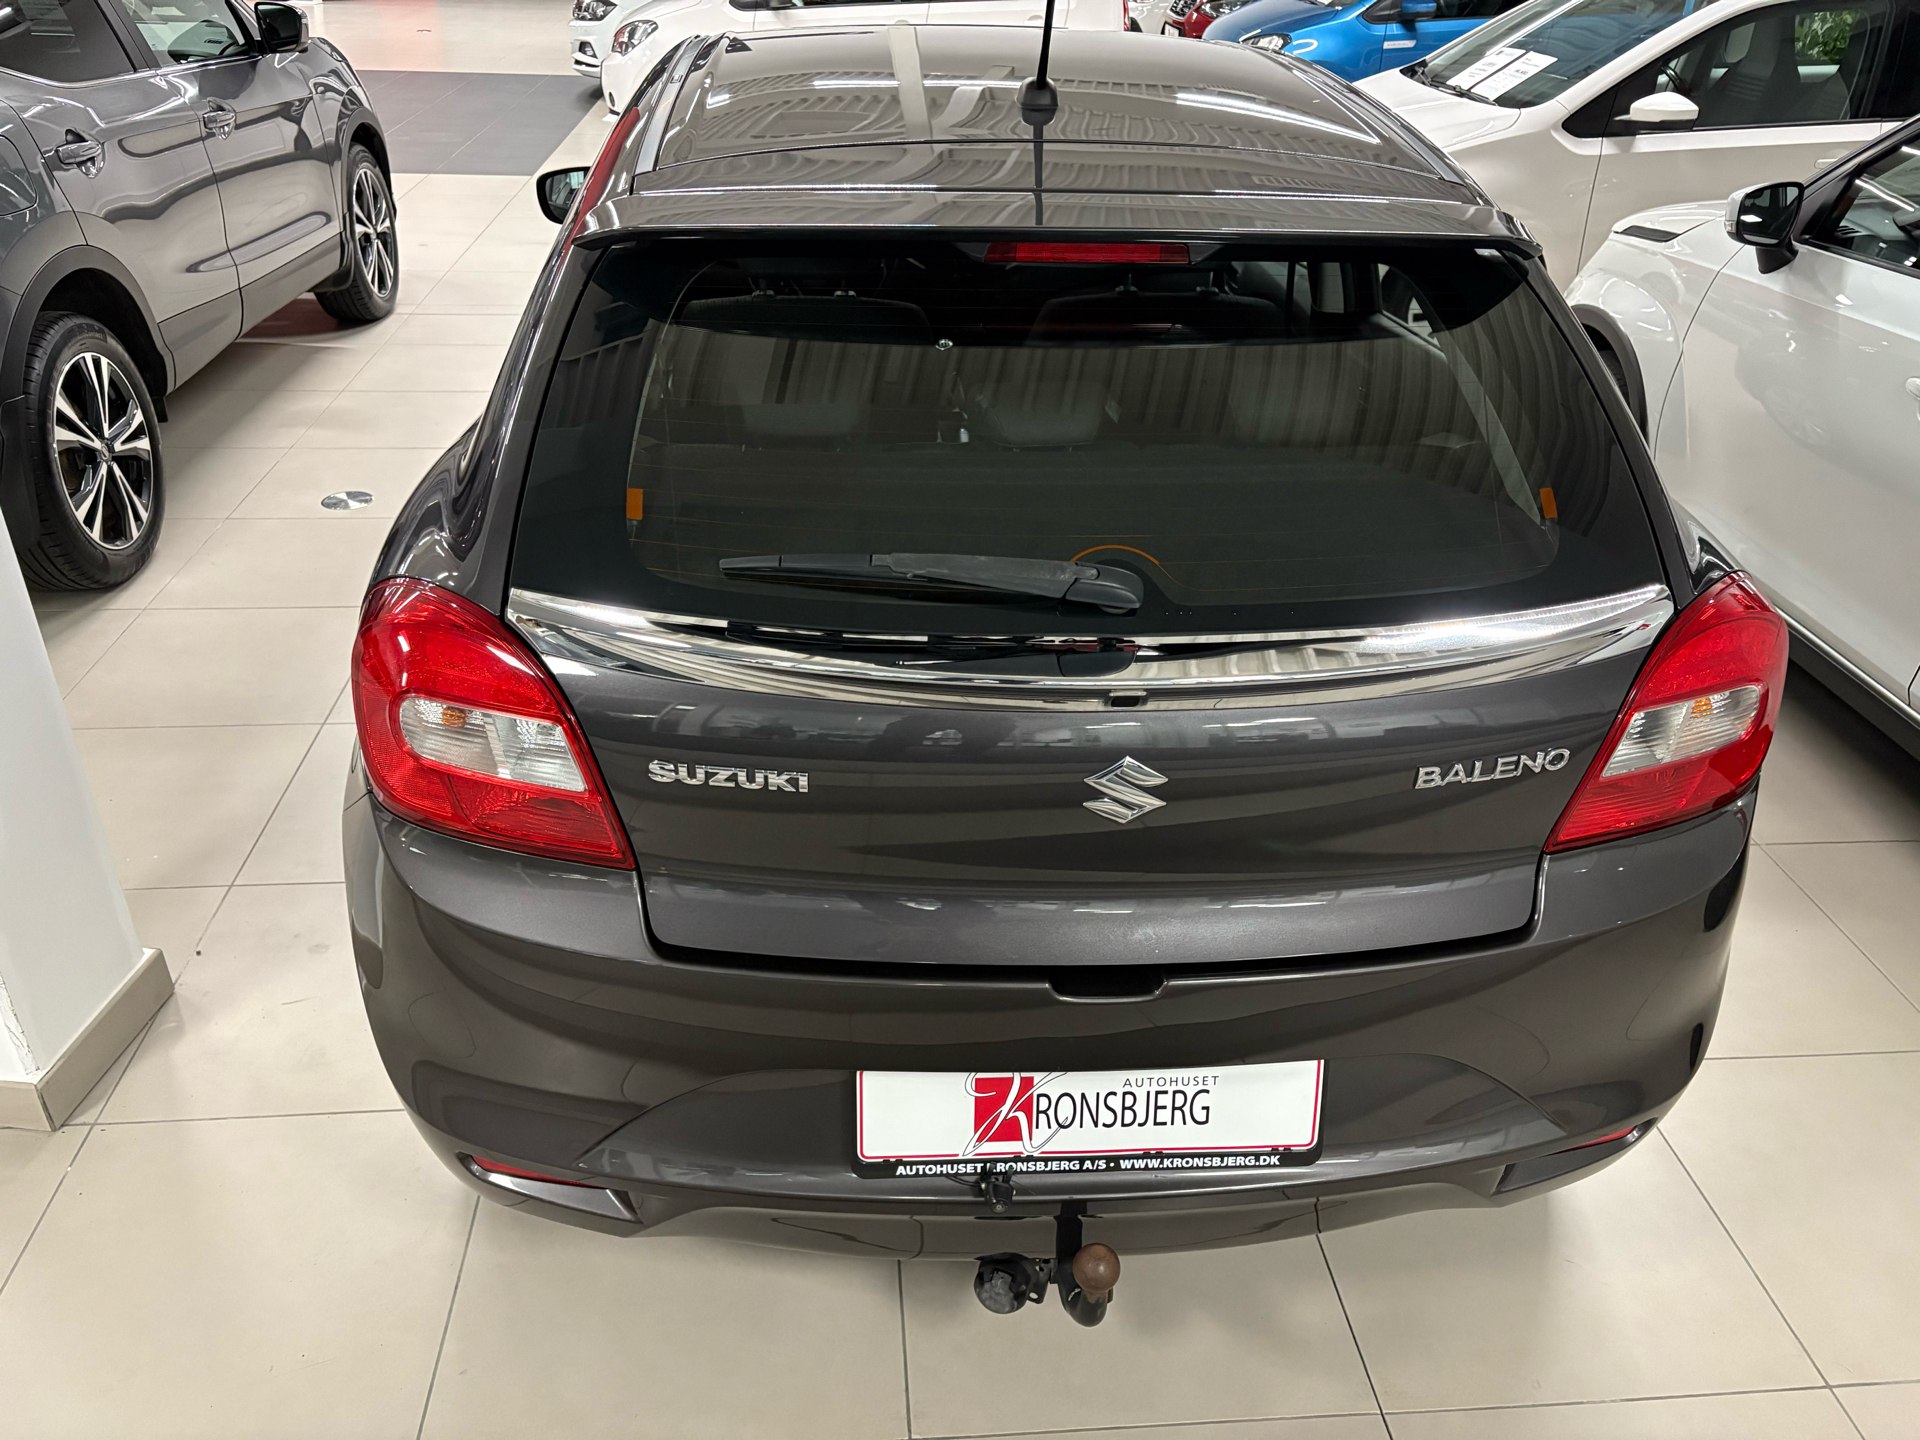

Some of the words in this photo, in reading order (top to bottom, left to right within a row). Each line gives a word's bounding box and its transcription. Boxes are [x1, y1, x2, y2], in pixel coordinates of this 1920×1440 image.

[648, 759, 809, 793] SUZUKI
[1415, 748, 1571, 790] BALENO
[1123, 1075, 1220, 1089] AUTOHUSET
[895, 1163, 984, 1176] AUTOHUSET
[1082, 1159, 1107, 1171] A/S
[1119, 1155, 1281, 1169] WWW.KRONSBJERG.DK
